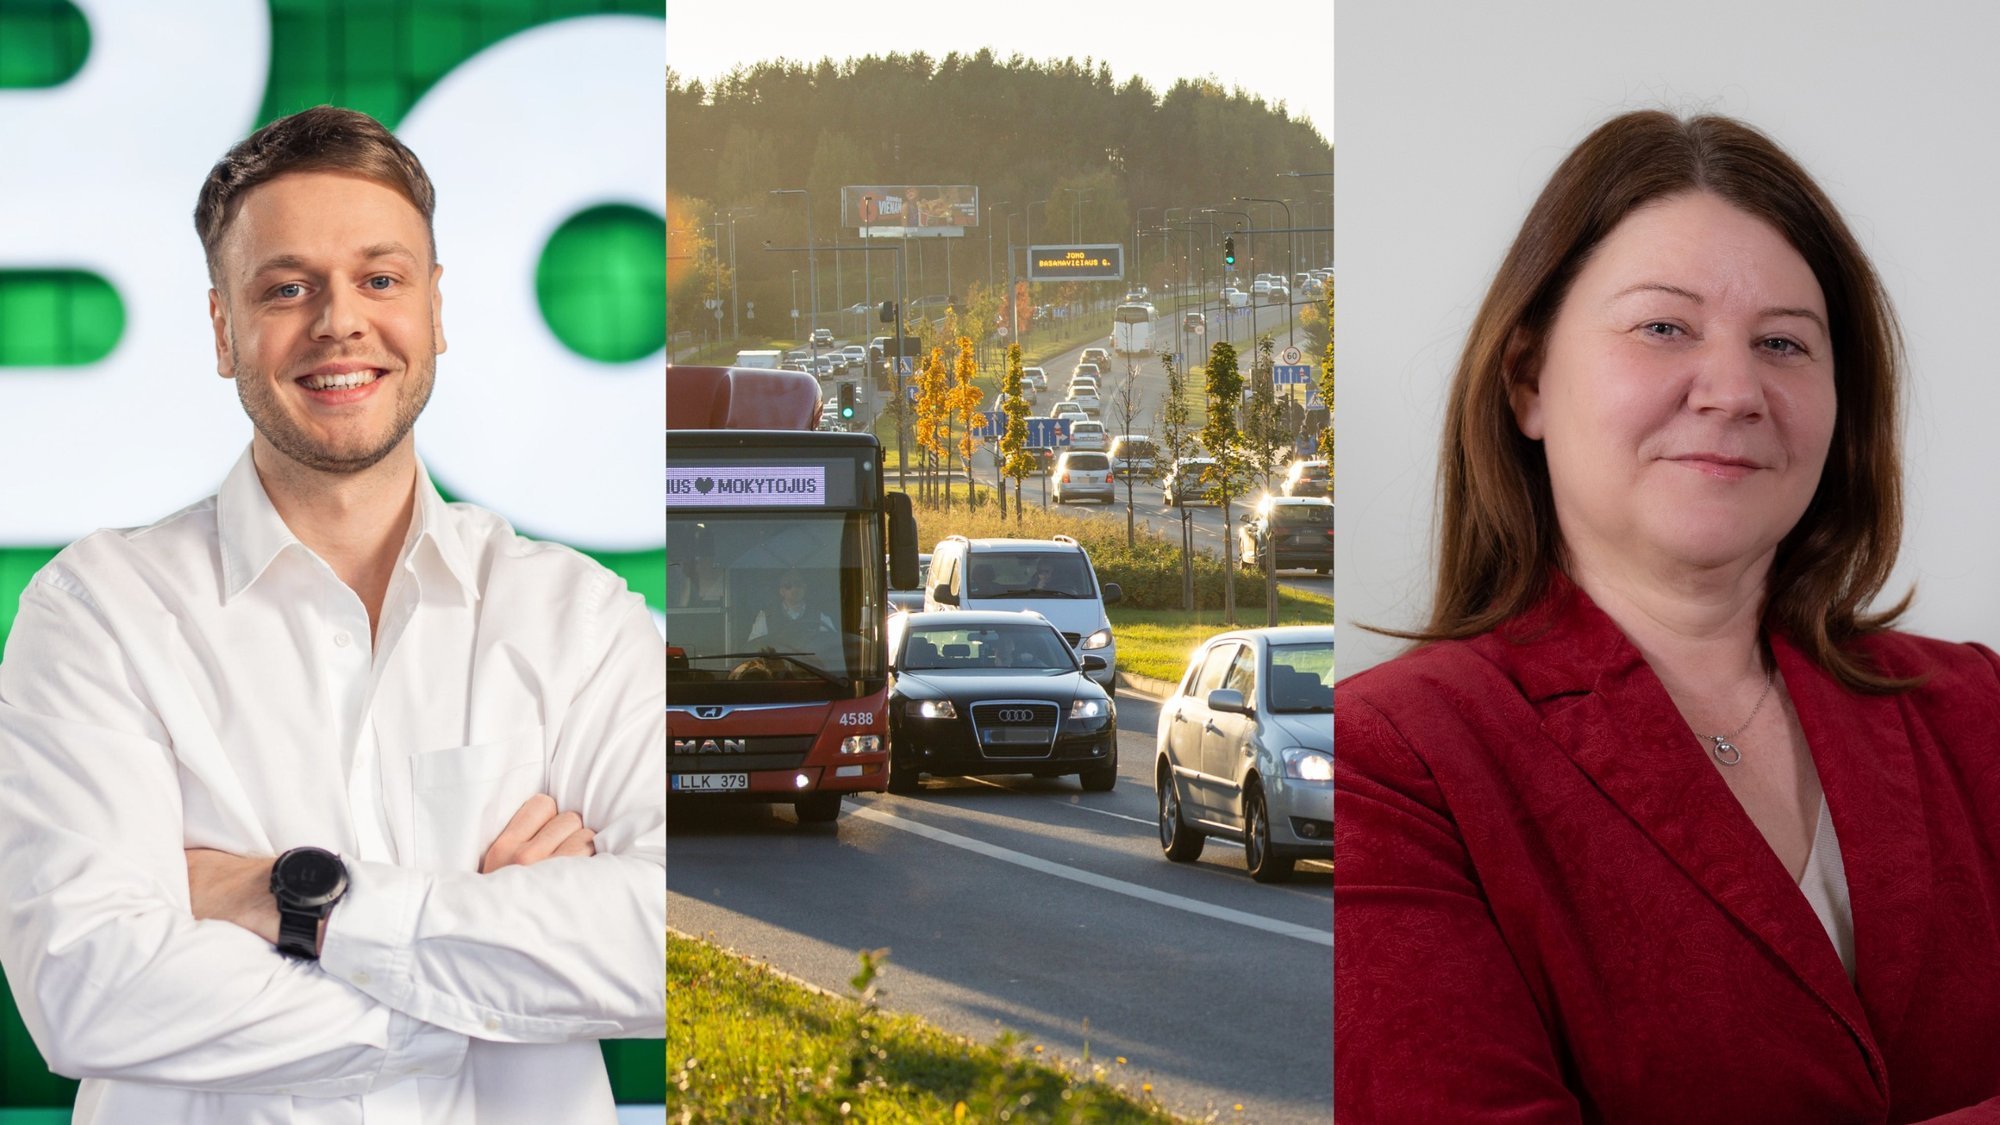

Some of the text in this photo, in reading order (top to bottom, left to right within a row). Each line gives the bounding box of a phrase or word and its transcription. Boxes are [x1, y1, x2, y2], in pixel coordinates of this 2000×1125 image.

[1287, 352, 1297, 360] 60
[718, 478, 816, 494] MOKYTOJUS
[839, 712, 873, 726] 4588
[674, 739, 746, 754] MAN
[681, 775, 711, 789] LLK
[721, 774, 745, 788] 379
